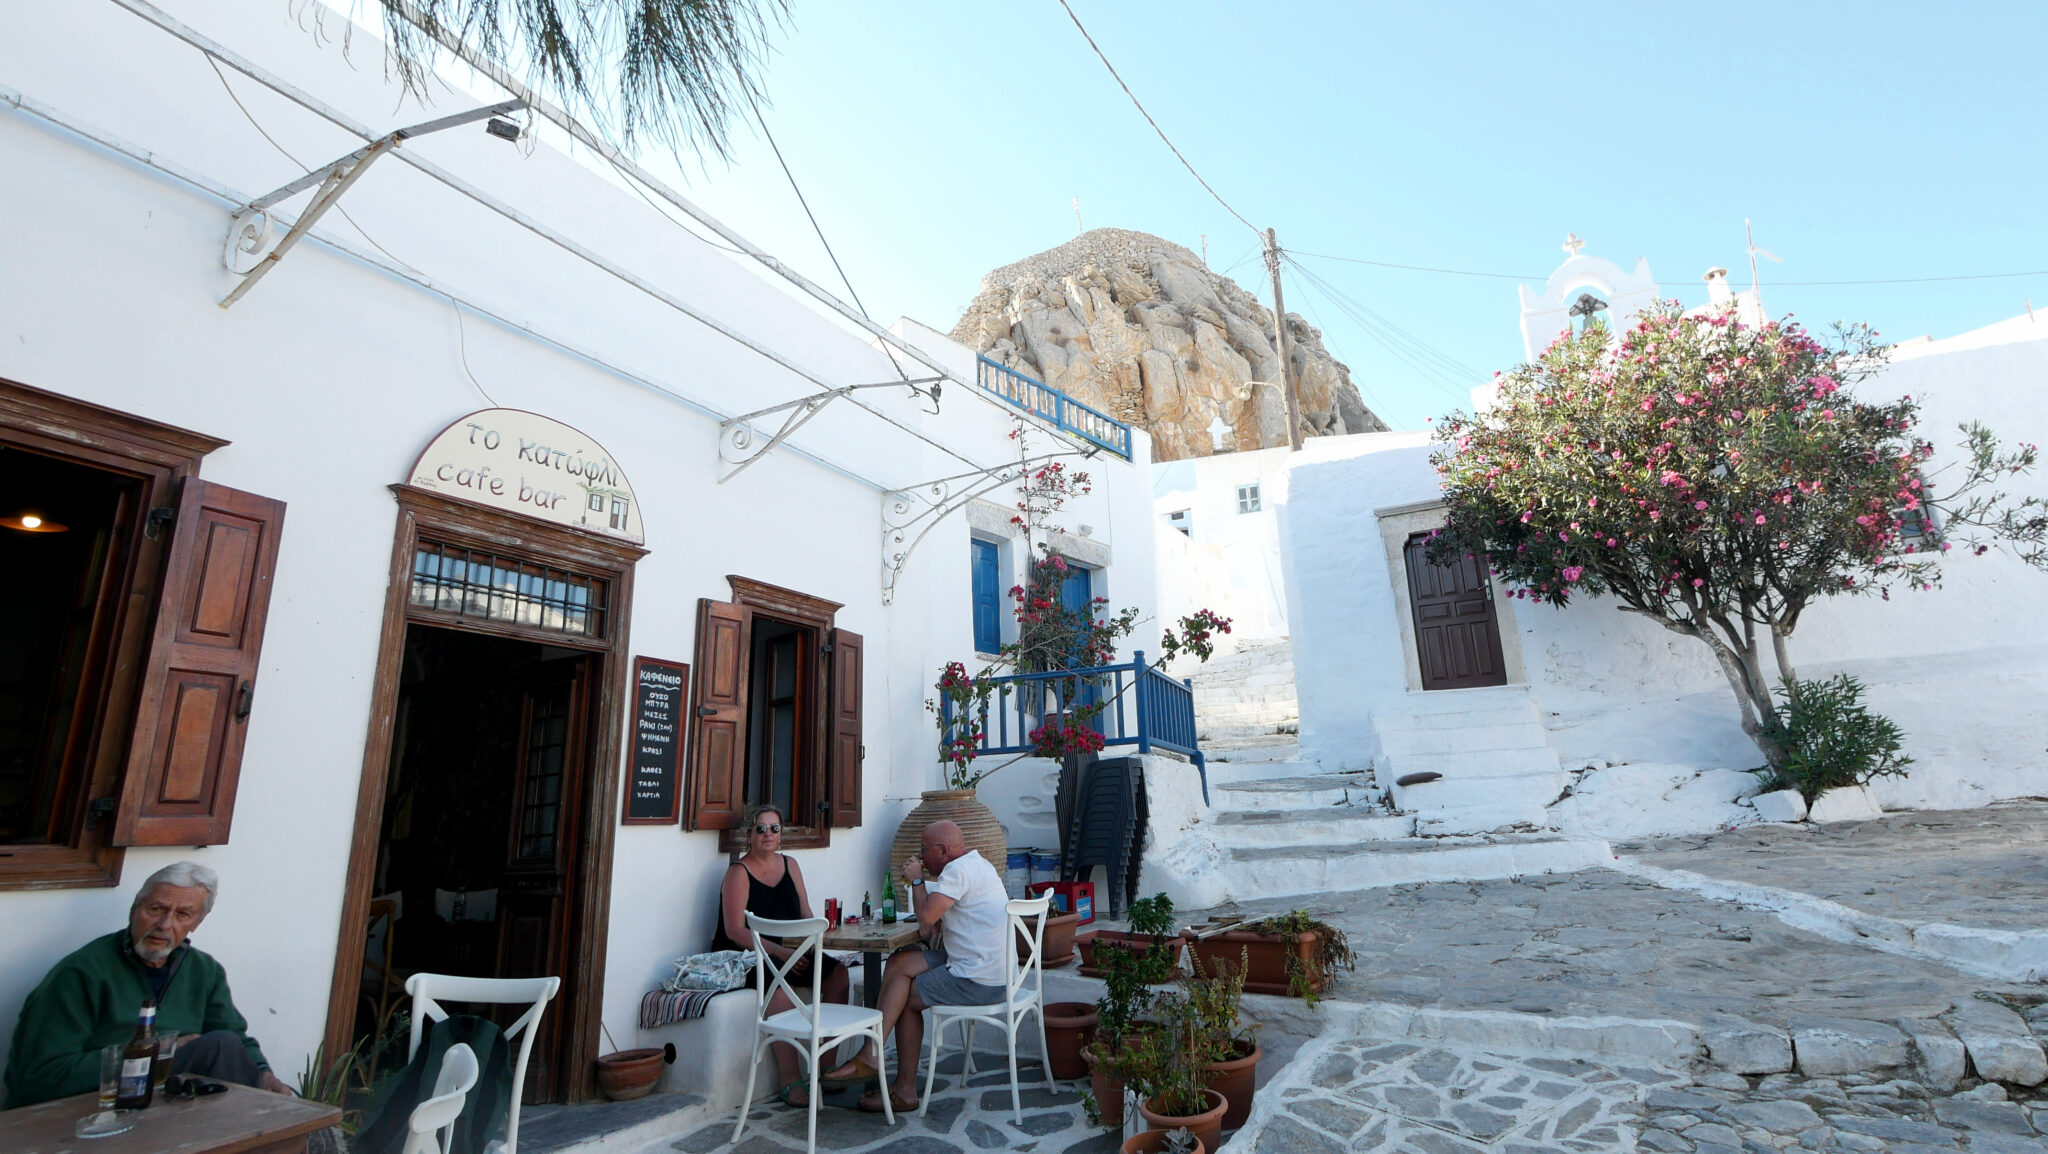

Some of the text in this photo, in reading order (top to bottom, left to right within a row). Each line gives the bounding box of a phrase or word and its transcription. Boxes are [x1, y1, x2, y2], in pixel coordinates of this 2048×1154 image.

[518, 437, 618, 487] κατώφλι
[437, 463, 567, 510] cafe bar
[640, 669, 682, 685] ΚΑΦΕΝΕΙΟ
[649, 692, 669, 701] ΟΥΖΟ
[642, 746, 662, 755] ΚΡΑΣΙ
[638, 780, 660, 788] ΤΑΒΛΙ
[637, 791, 660, 799] ΧΑΡΤΙΑ
